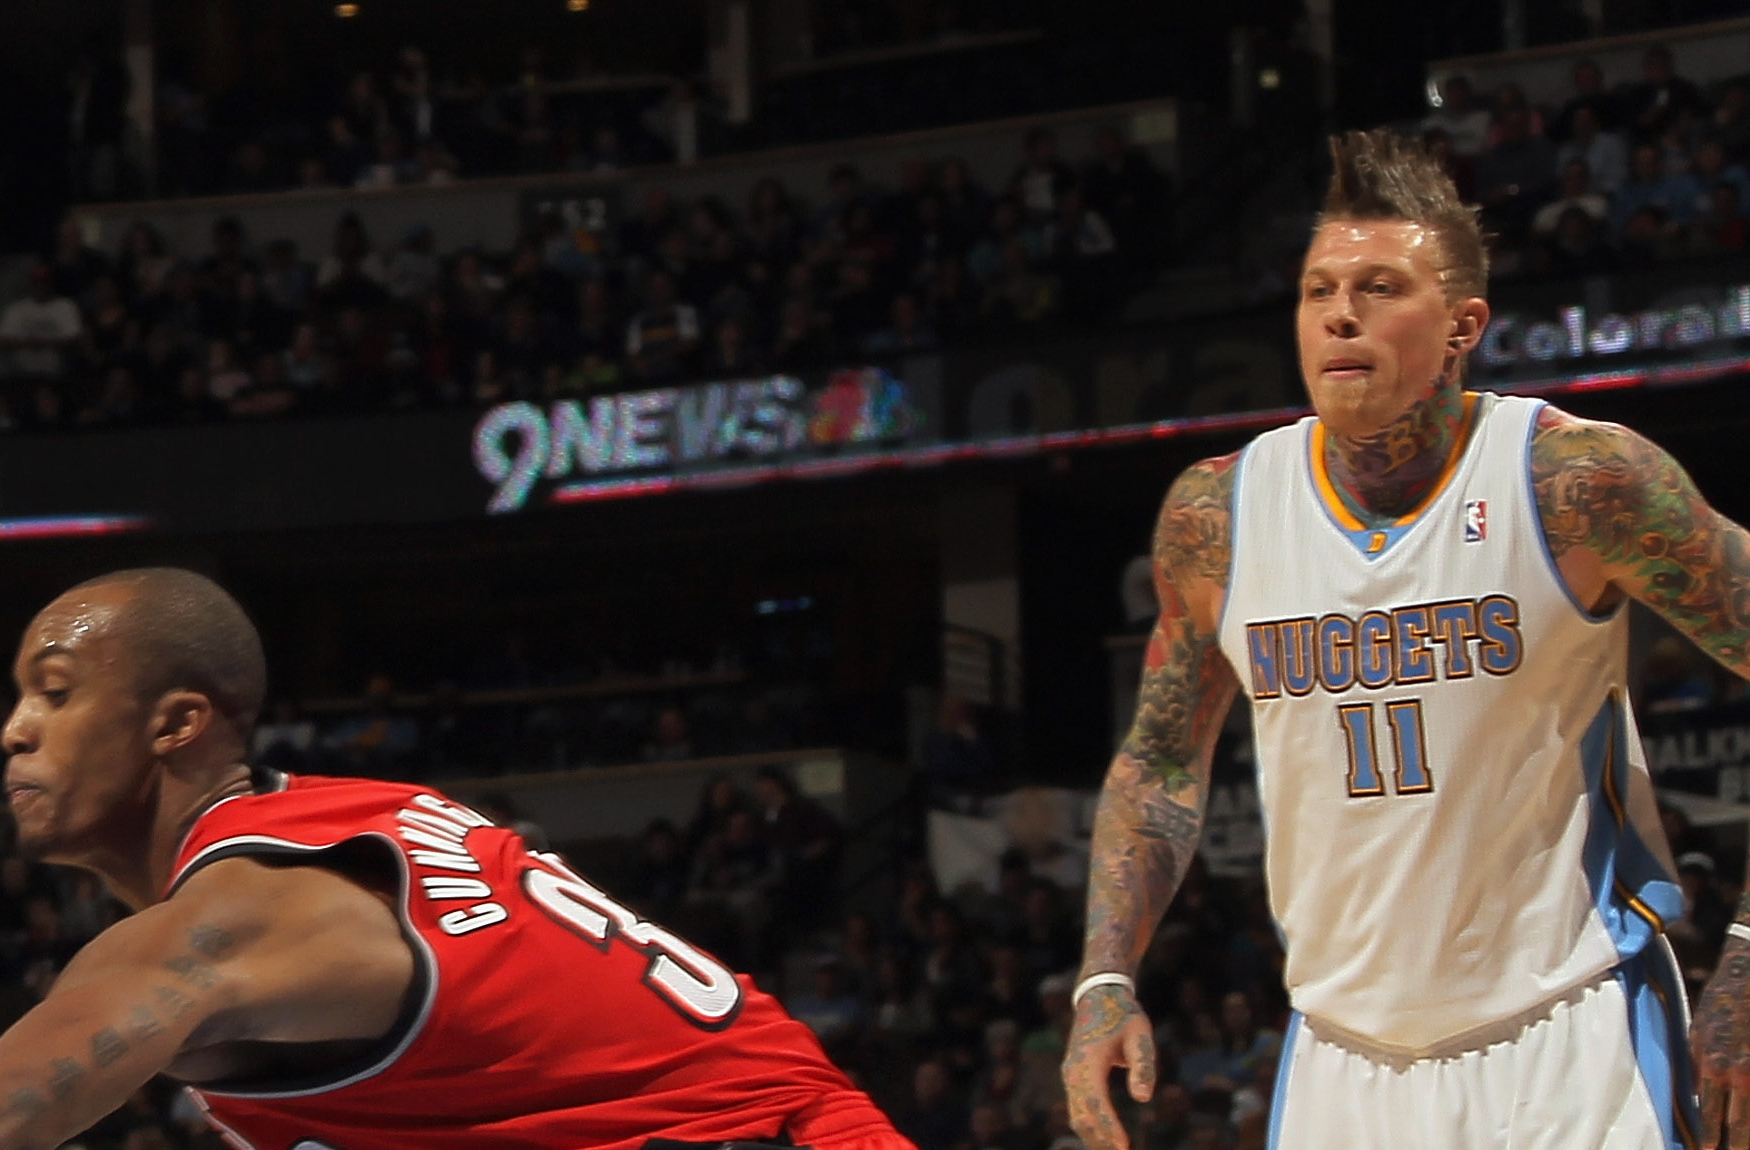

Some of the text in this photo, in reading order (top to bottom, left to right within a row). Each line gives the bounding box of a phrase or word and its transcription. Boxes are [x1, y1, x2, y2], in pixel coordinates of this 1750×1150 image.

[472, 374, 805, 516] 9NEWS
[1246, 594, 1522, 699] NUGGETS
[1338, 699, 1434, 798] 11
[518, 848, 744, 1030] 3
